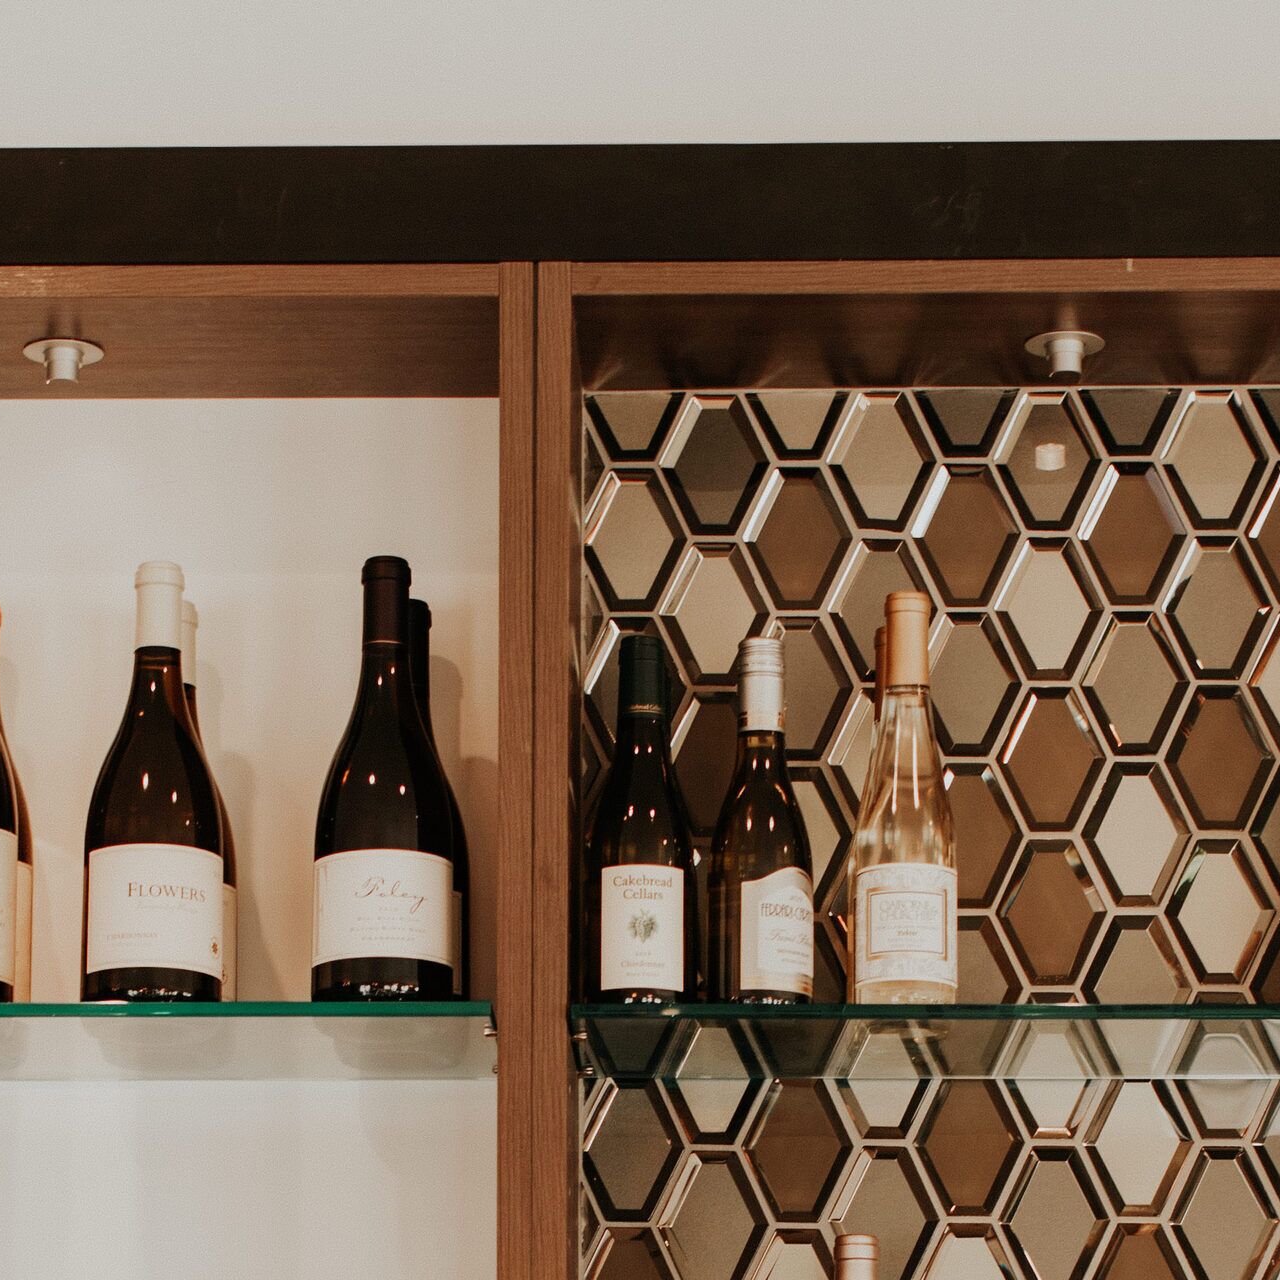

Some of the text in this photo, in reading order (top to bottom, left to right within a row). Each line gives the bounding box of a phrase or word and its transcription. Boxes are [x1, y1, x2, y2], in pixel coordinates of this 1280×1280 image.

[612, 875, 673, 888] Cakebread
[127, 881, 206, 903] FLOWERS
[622, 888, 663, 900] Cellars
